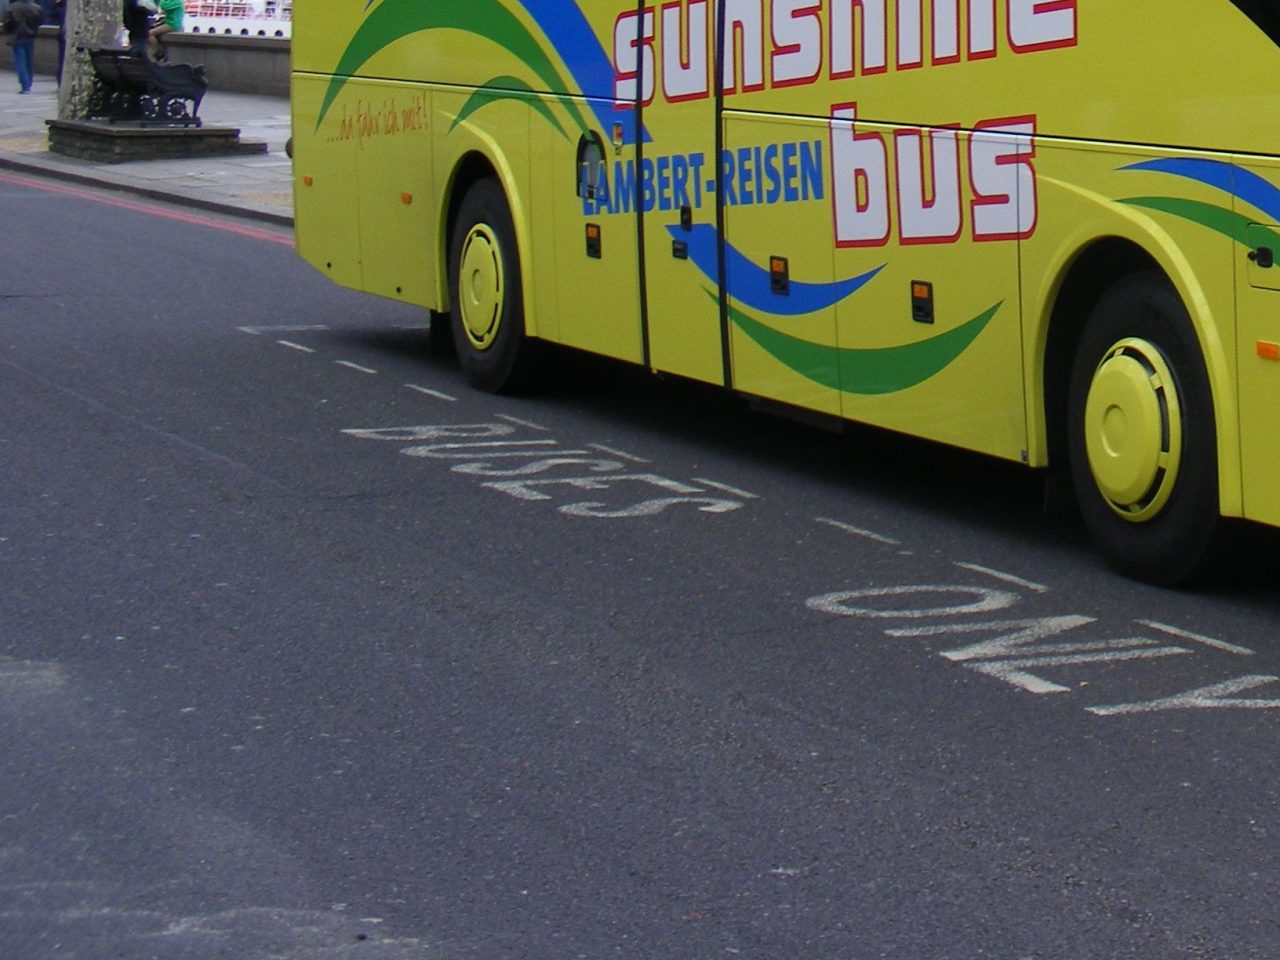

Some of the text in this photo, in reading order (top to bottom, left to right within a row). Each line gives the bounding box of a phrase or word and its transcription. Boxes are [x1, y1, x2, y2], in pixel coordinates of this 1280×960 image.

[582, 139, 824, 216] LAMBERT-REISEN
[830, 102, 1038, 249] bus
[339, 423, 744, 518] BUSES
